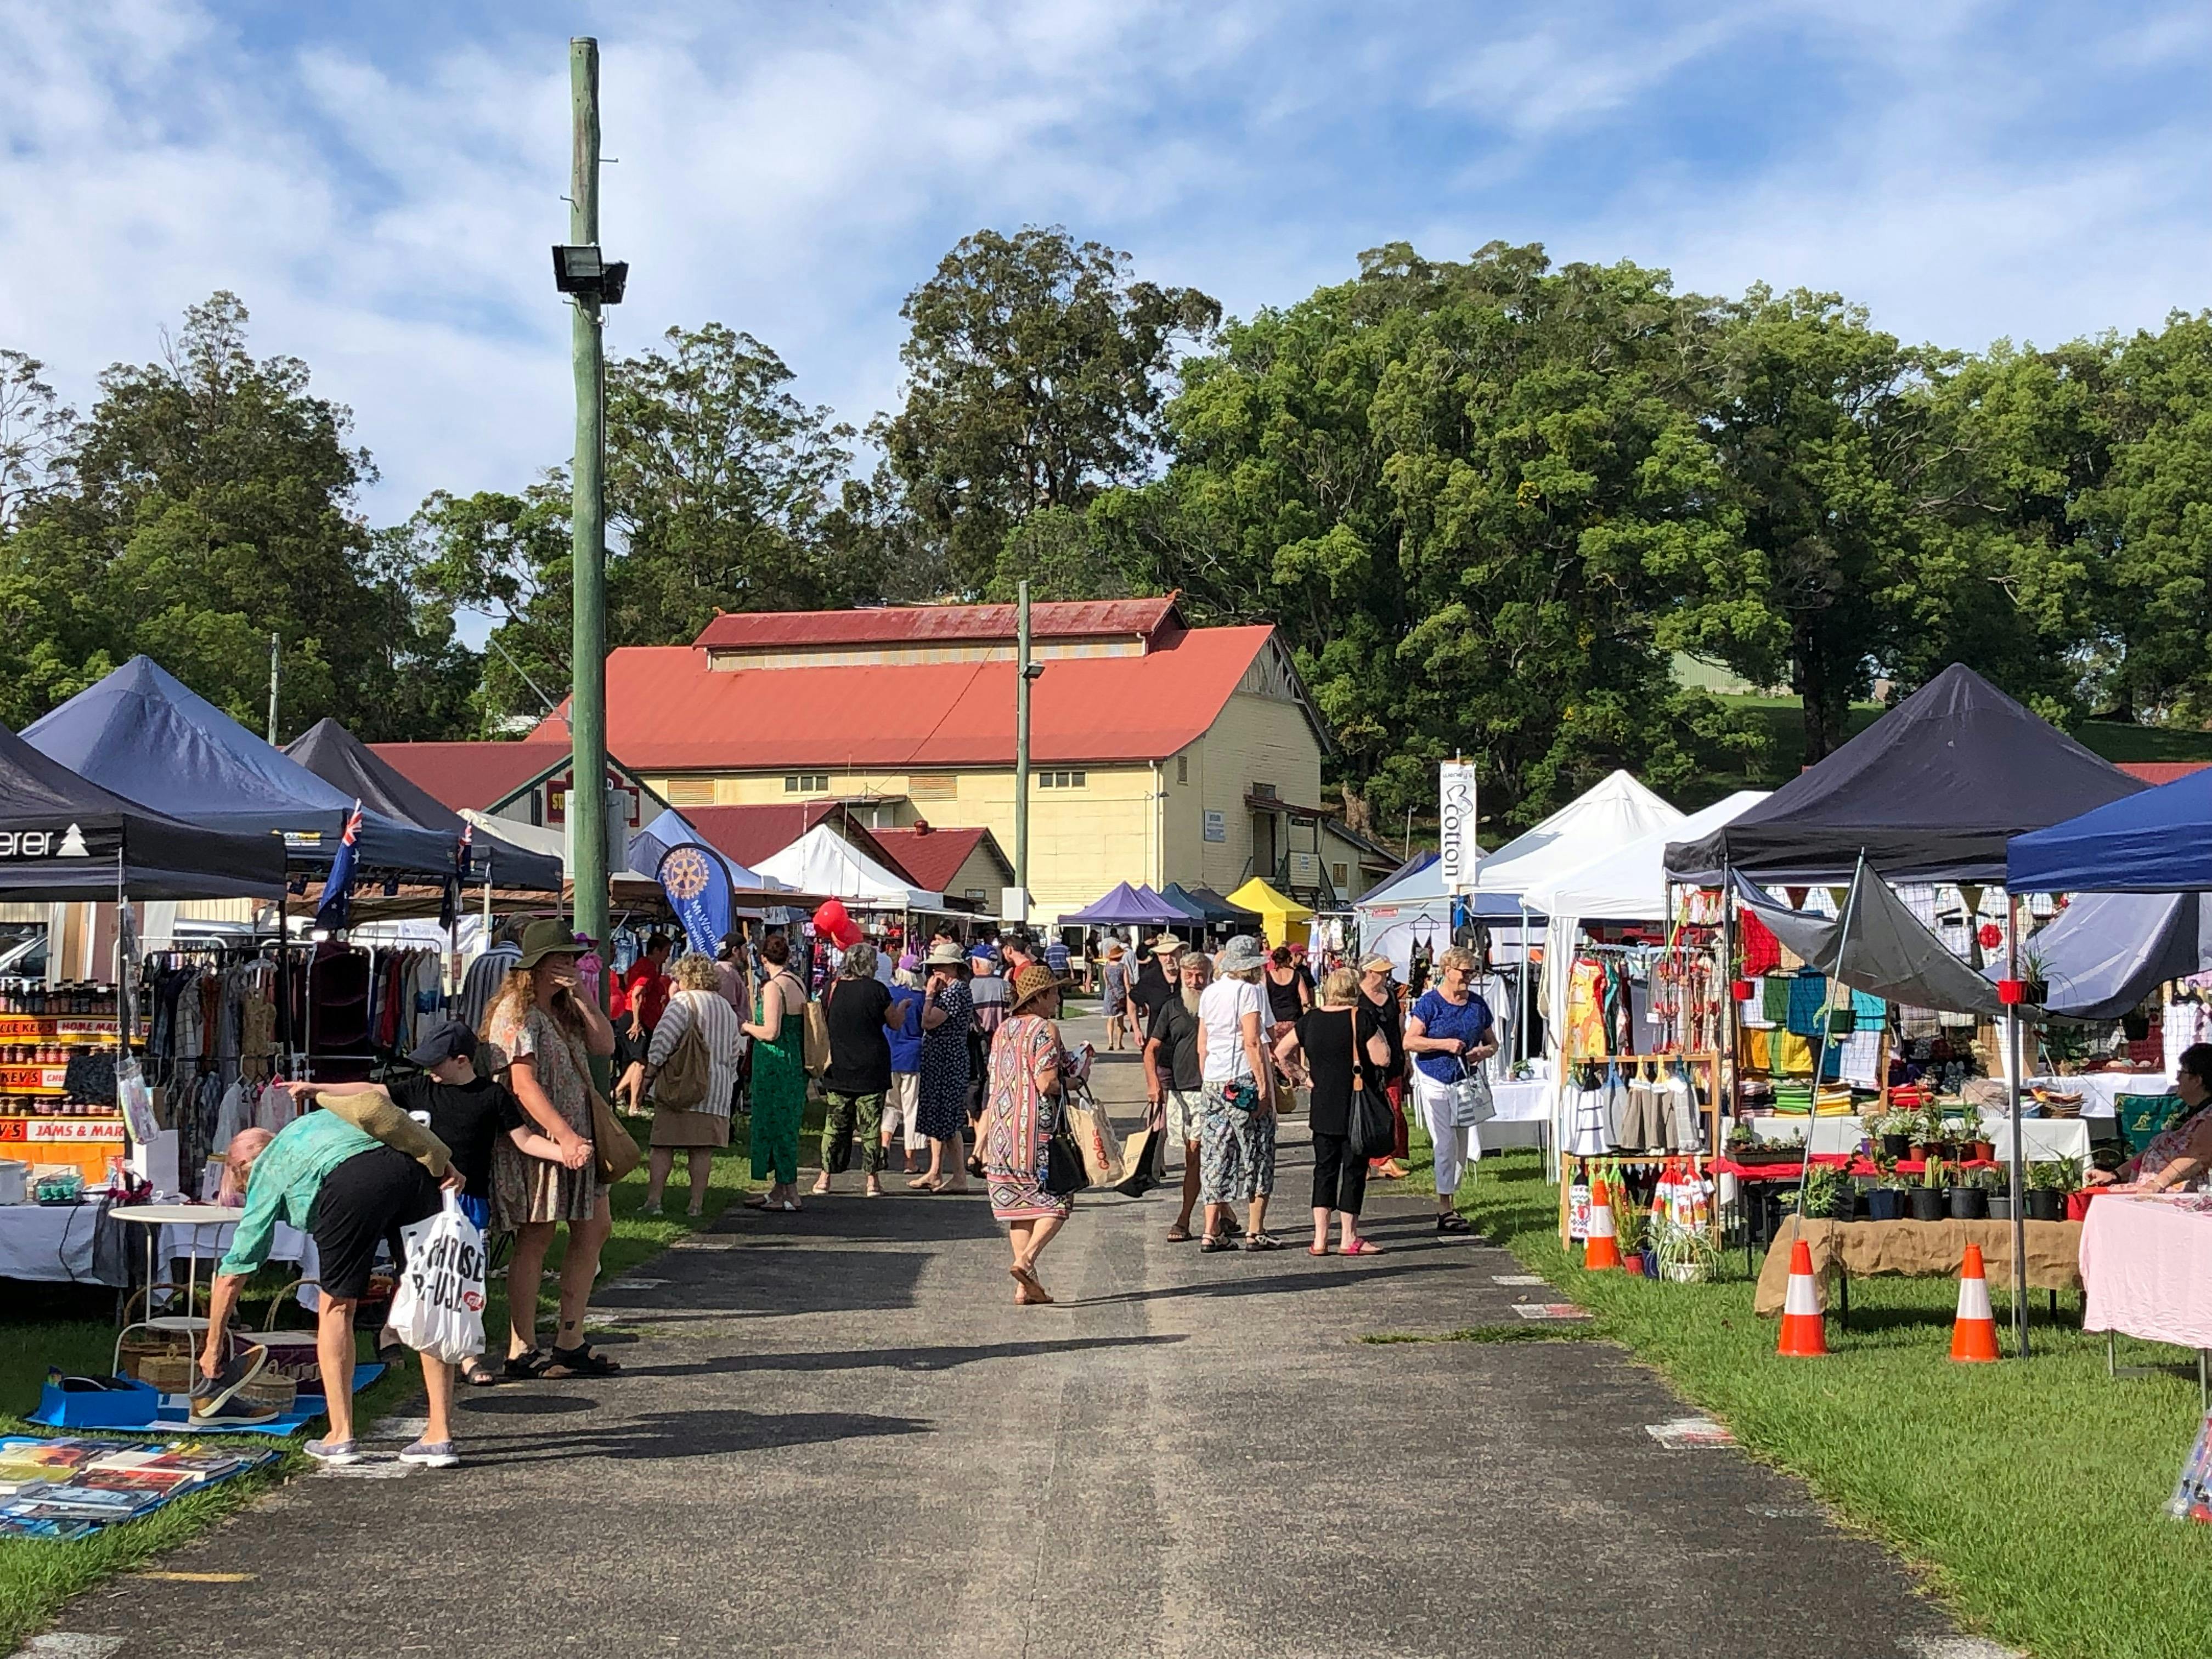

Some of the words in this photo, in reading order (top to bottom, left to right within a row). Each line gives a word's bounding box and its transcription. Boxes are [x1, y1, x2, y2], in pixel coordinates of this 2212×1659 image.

[1444, 804, 1460, 877] cotton
[691, 900, 703, 915] Mt
[61, 1022, 93, 1031] HOME
[35, 1125, 72, 1137] JAMS
[76, 1125, 86, 1137] &
